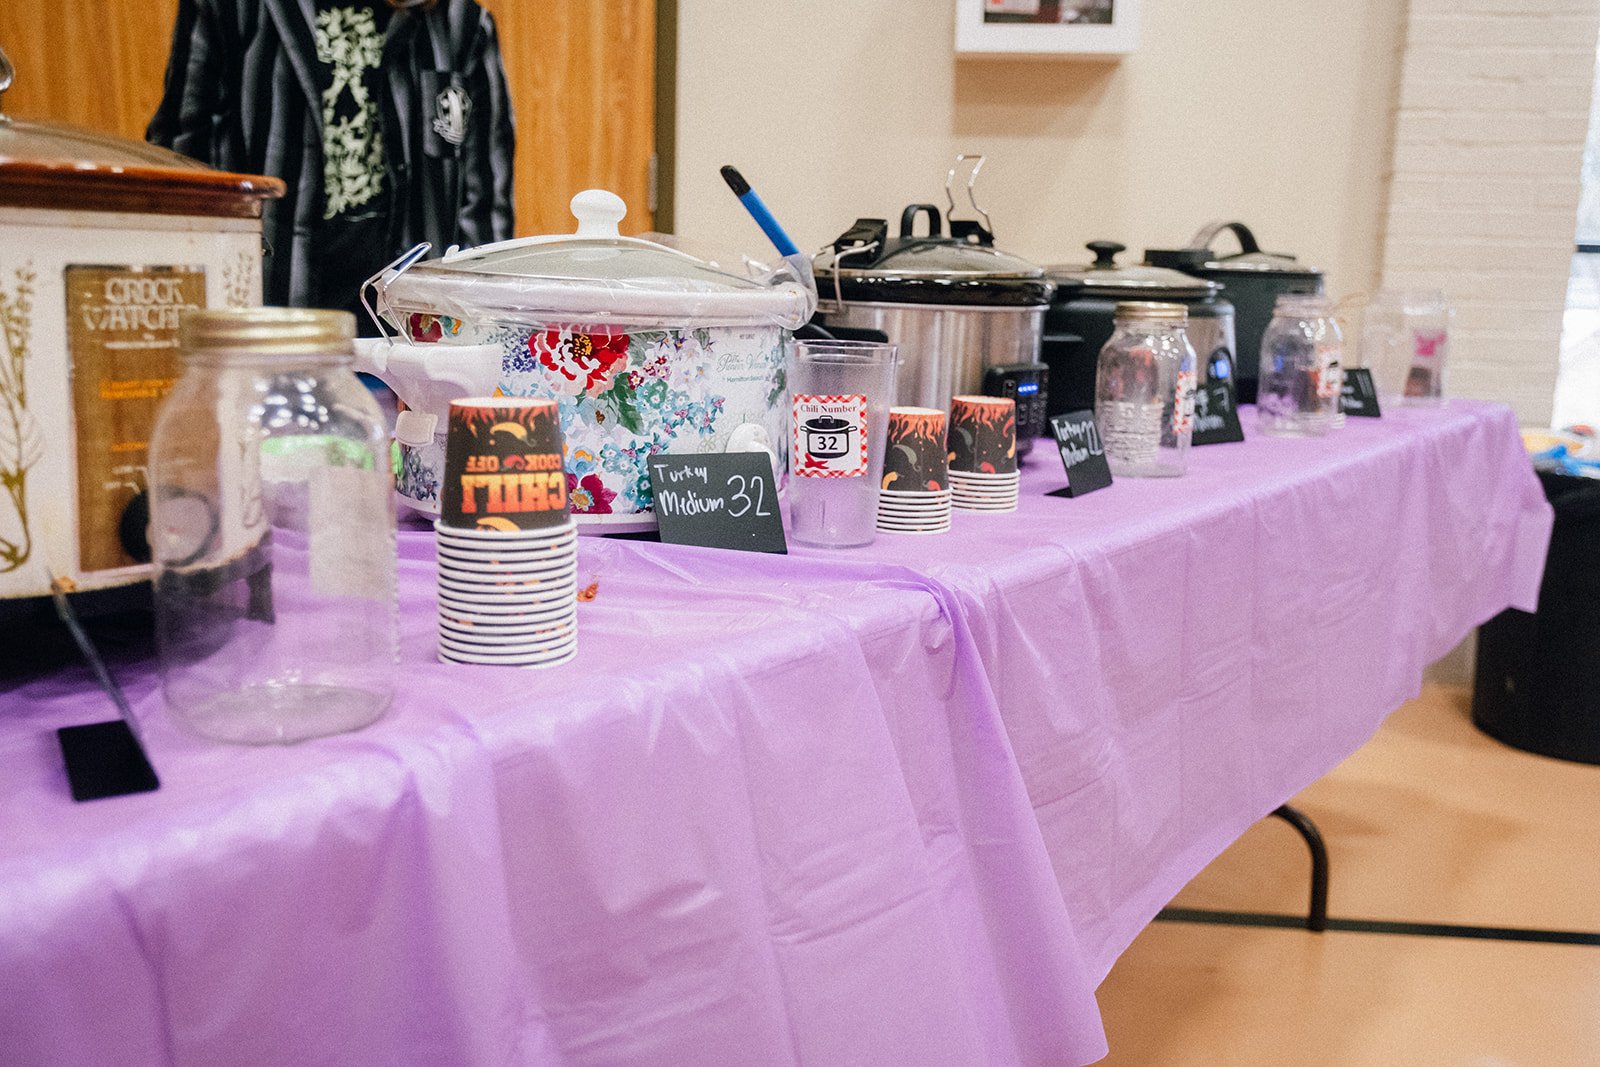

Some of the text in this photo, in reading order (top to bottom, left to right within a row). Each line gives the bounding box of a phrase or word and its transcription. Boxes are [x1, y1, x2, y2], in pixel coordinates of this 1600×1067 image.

[105, 277, 184, 304] CROCK
[81, 304, 200, 330] WATCH
[800, 404, 857, 413] Chili Number
[817, 436, 838, 451] 32
[465, 453, 562, 473] COOK OFF
[653, 464, 708, 484] Turkey
[460, 472, 567, 514] CHILI
[659, 474, 772, 518] Medium 32
